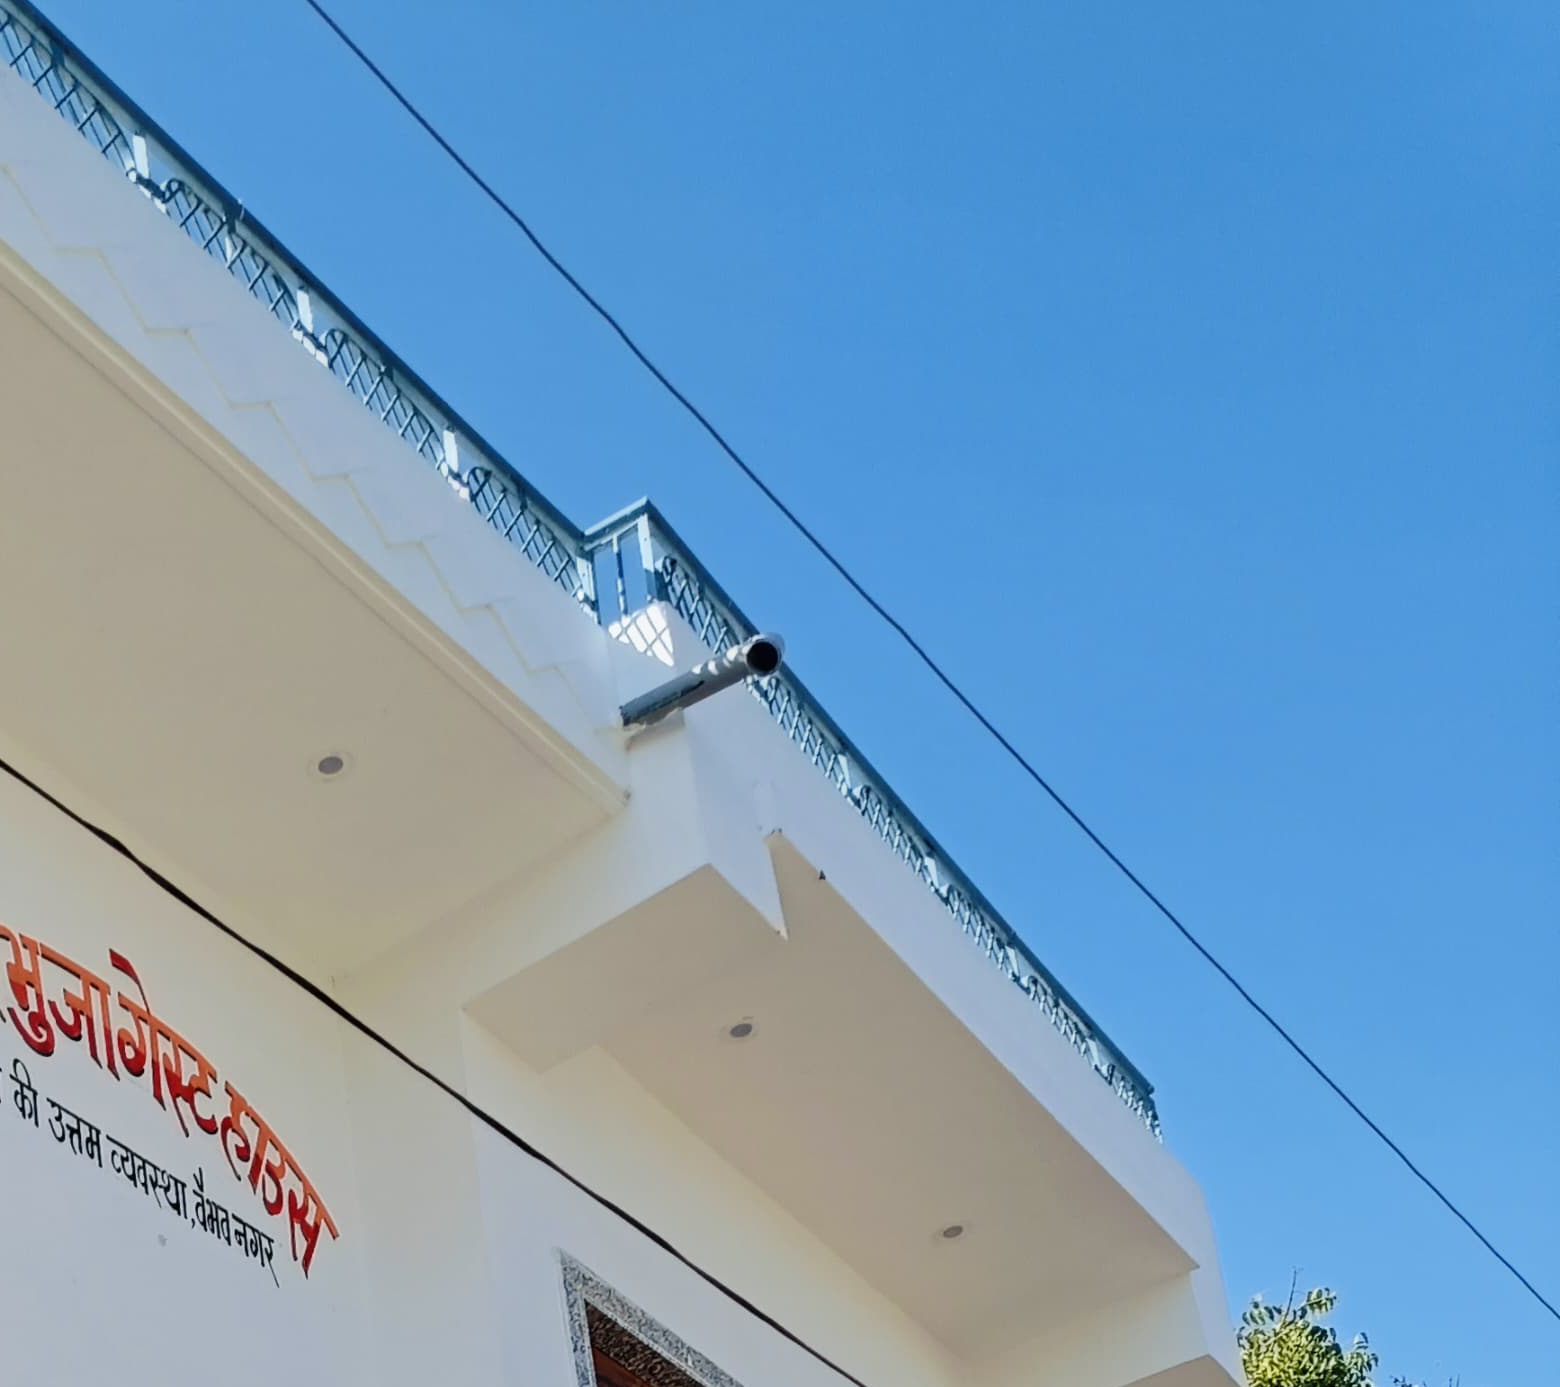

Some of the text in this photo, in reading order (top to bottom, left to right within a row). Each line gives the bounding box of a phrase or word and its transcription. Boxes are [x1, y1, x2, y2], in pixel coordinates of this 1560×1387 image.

[9, 1057, 40, 1128] की
[45, 1096, 103, 1168] उत्तम
[231, 1212, 280, 1289] नगर
[220, 1080, 340, 1280] हाउस
